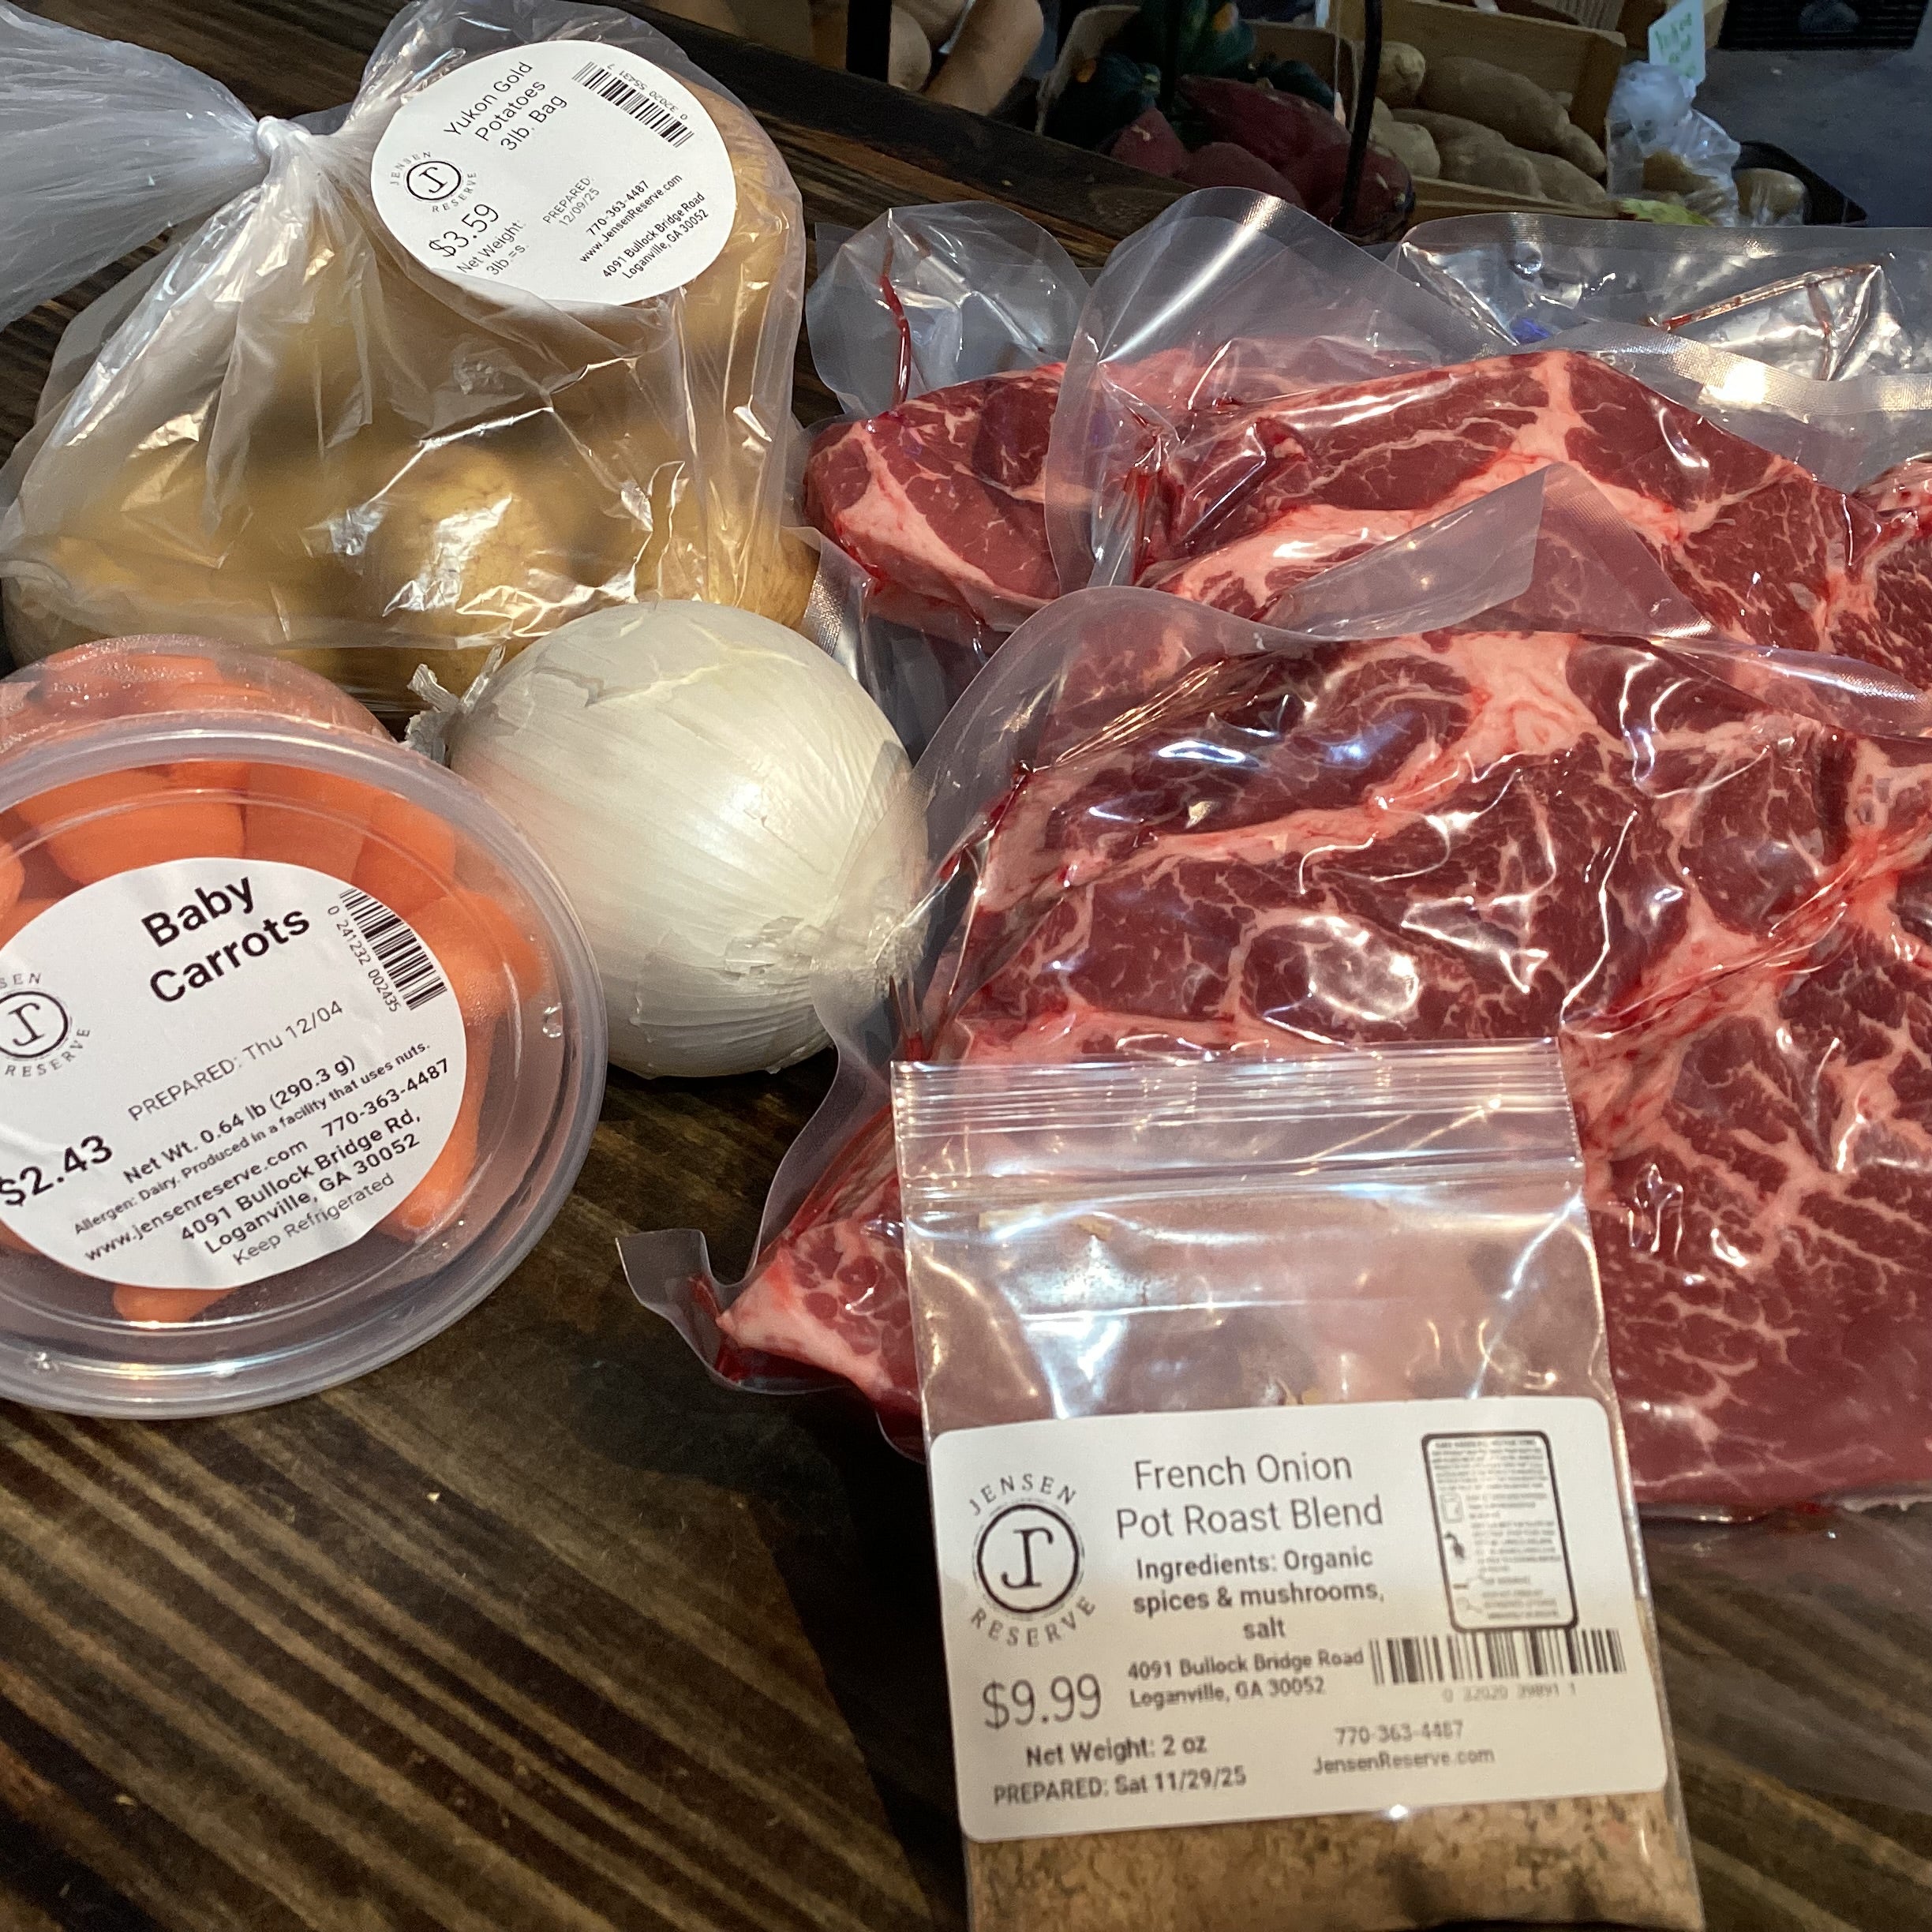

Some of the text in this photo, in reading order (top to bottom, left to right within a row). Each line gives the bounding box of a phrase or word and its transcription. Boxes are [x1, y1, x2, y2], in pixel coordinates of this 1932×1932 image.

[444, 61, 534, 136] Yukon Gold
[475, 81, 546, 141] Potatoes
[500, 95, 567, 150] 3lb. Bag
[649, 90, 680, 113] 32020
[390, 152, 431, 185] JENSEN
[432, 172, 477, 212] RESERVE
[543, 176, 594, 224] PREPARED:
[559, 188, 599, 227] 12/09/25
[580, 174, 683, 263] www.JensenReserve.com
[586, 180, 650, 236] 770-363-4487
[429, 204, 499, 257] $3.59
[603, 192, 706, 278] 4091 Bullock Bridge Road
[623, 208, 709, 279] Loganville, GA 30052
[457, 256, 484, 273] Net
[140, 876, 256, 948] Baby
[149, 906, 311, 1002] Carrots
[328, 905, 402, 1012] 0 241232 002435
[5, 1028, 90, 1077] RESERVE
[128, 1000, 343, 1121] PREPARED: Thu 12/04
[75, 1043, 430, 1234] Allergen: Dairy. Produced in a facility that uses nuts.
[123, 1054, 355, 1184] Net Wt. 0.64 lb (290.3 g)
[0, 1135, 113, 1207] $2.43
[85, 1058, 448, 1261] www.jensenreserve.com 770-363-4487
[182, 1109, 421, 1241] 4091 Bullock Bridge Rd,
[204, 1133, 420, 1254] Loganville, GA 30052
[233, 1173, 395, 1265] Keep Refrigerated
[969, 1473, 1076, 1516] JENSEN
[1134, 1452, 1353, 1490] French Onion
[1116, 1494, 1383, 1540] Pot Roast Blend
[1136, 1545, 1373, 1585] Ingredients: Organic
[971, 1596, 1095, 1647] RESERVE
[1133, 1581, 1384, 1619] spices & mushrooms,
[1243, 1616, 1286, 1640] salt
[1129, 1647, 1364, 1680] 4091 Bullock Bridge Road
[983, 1673, 1102, 1729] $9.99
[1129, 1676, 1325, 1711] Loganville, GA 30052
[1027, 1734, 1208, 1768] Net Weight: 2 oz
[1313, 1748, 1495, 1776] JensenReserve.com
[994, 1765, 1246, 1805] PREPARED: Sat 11/29/25
